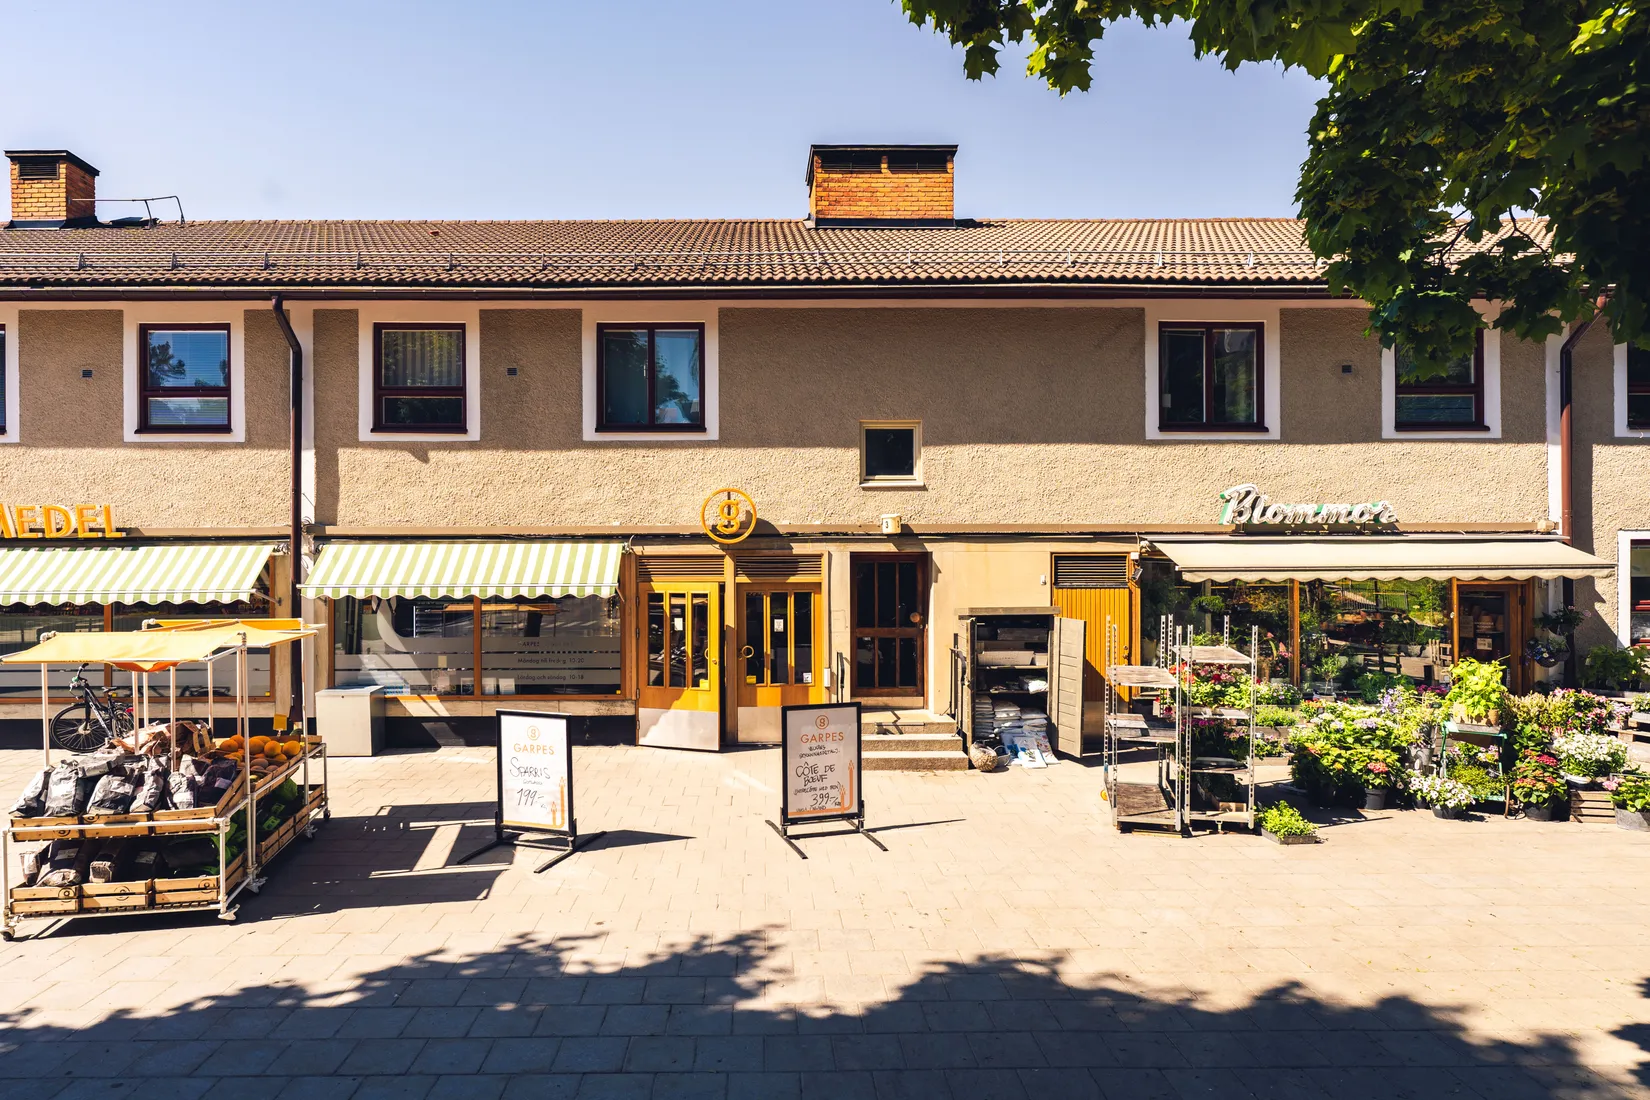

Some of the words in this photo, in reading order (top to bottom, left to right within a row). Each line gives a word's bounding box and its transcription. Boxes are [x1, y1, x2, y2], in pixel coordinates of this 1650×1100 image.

[1218, 483, 1398, 525] Blommor
[800, 731, 844, 744] GARPES
[513, 743, 555, 756] GARPES
[824, 763, 836, 773] DE
